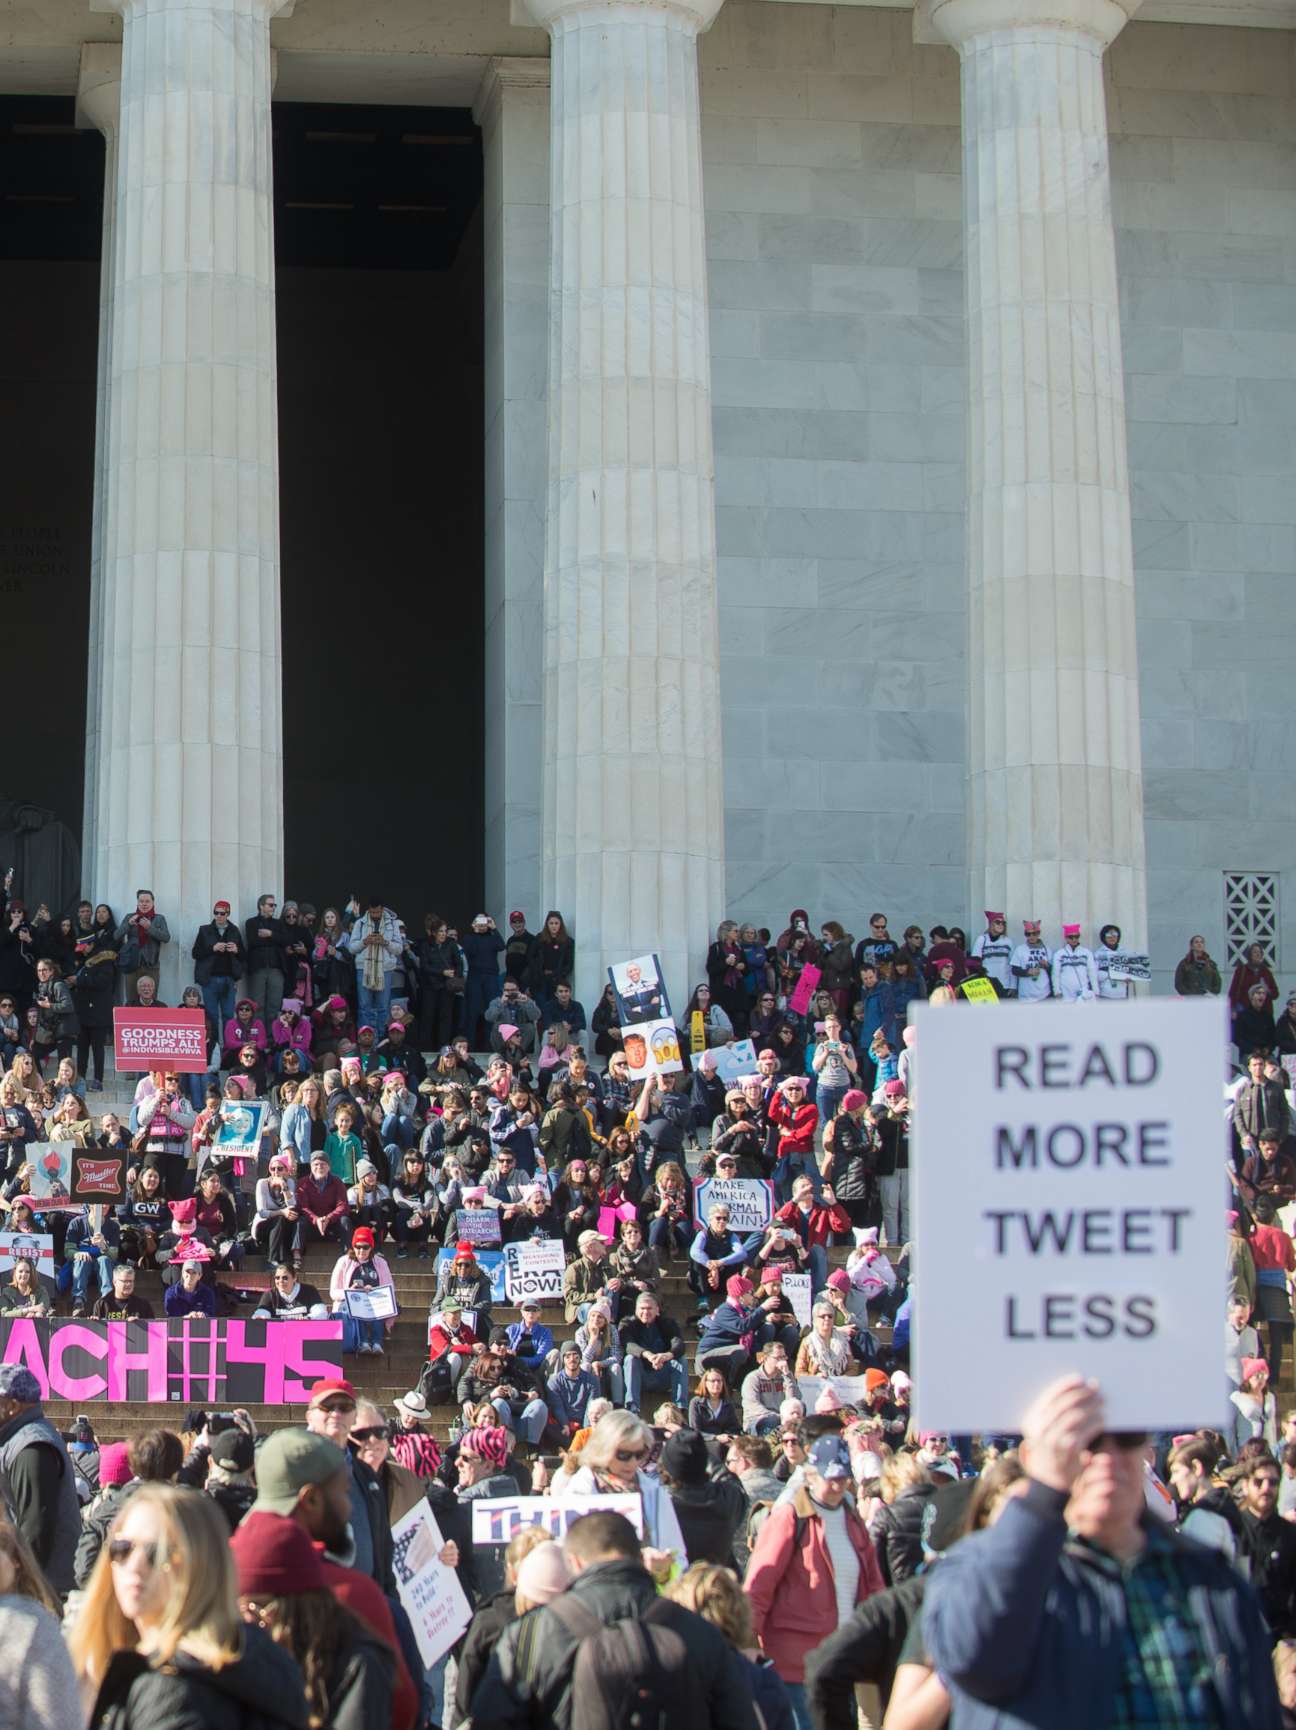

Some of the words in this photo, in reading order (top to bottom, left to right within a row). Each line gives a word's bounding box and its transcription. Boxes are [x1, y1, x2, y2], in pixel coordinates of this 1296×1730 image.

[121, 1028, 201, 1041] GOODNESS
[121, 1038, 176, 1048] TRUMPS
[178, 1040, 201, 1049] ALL
[994, 1042, 1161, 1090] READ
[994, 1120, 1171, 1171] MORE
[713, 1180, 745, 1190] MAKE
[707, 1190, 757, 1201] AMERICA
[135, 1202, 160, 1214] GW
[728, 1203, 762, 1214] RMAL
[730, 1214, 763, 1228] AIN!
[983, 1208, 1192, 1256] TWEET
[8, 1248, 45, 1257] RESIST
[510, 1279, 562, 1297] NOW!
[1004, 1294, 1158, 1340] LESS
[477, 1506, 635, 1541] THI
